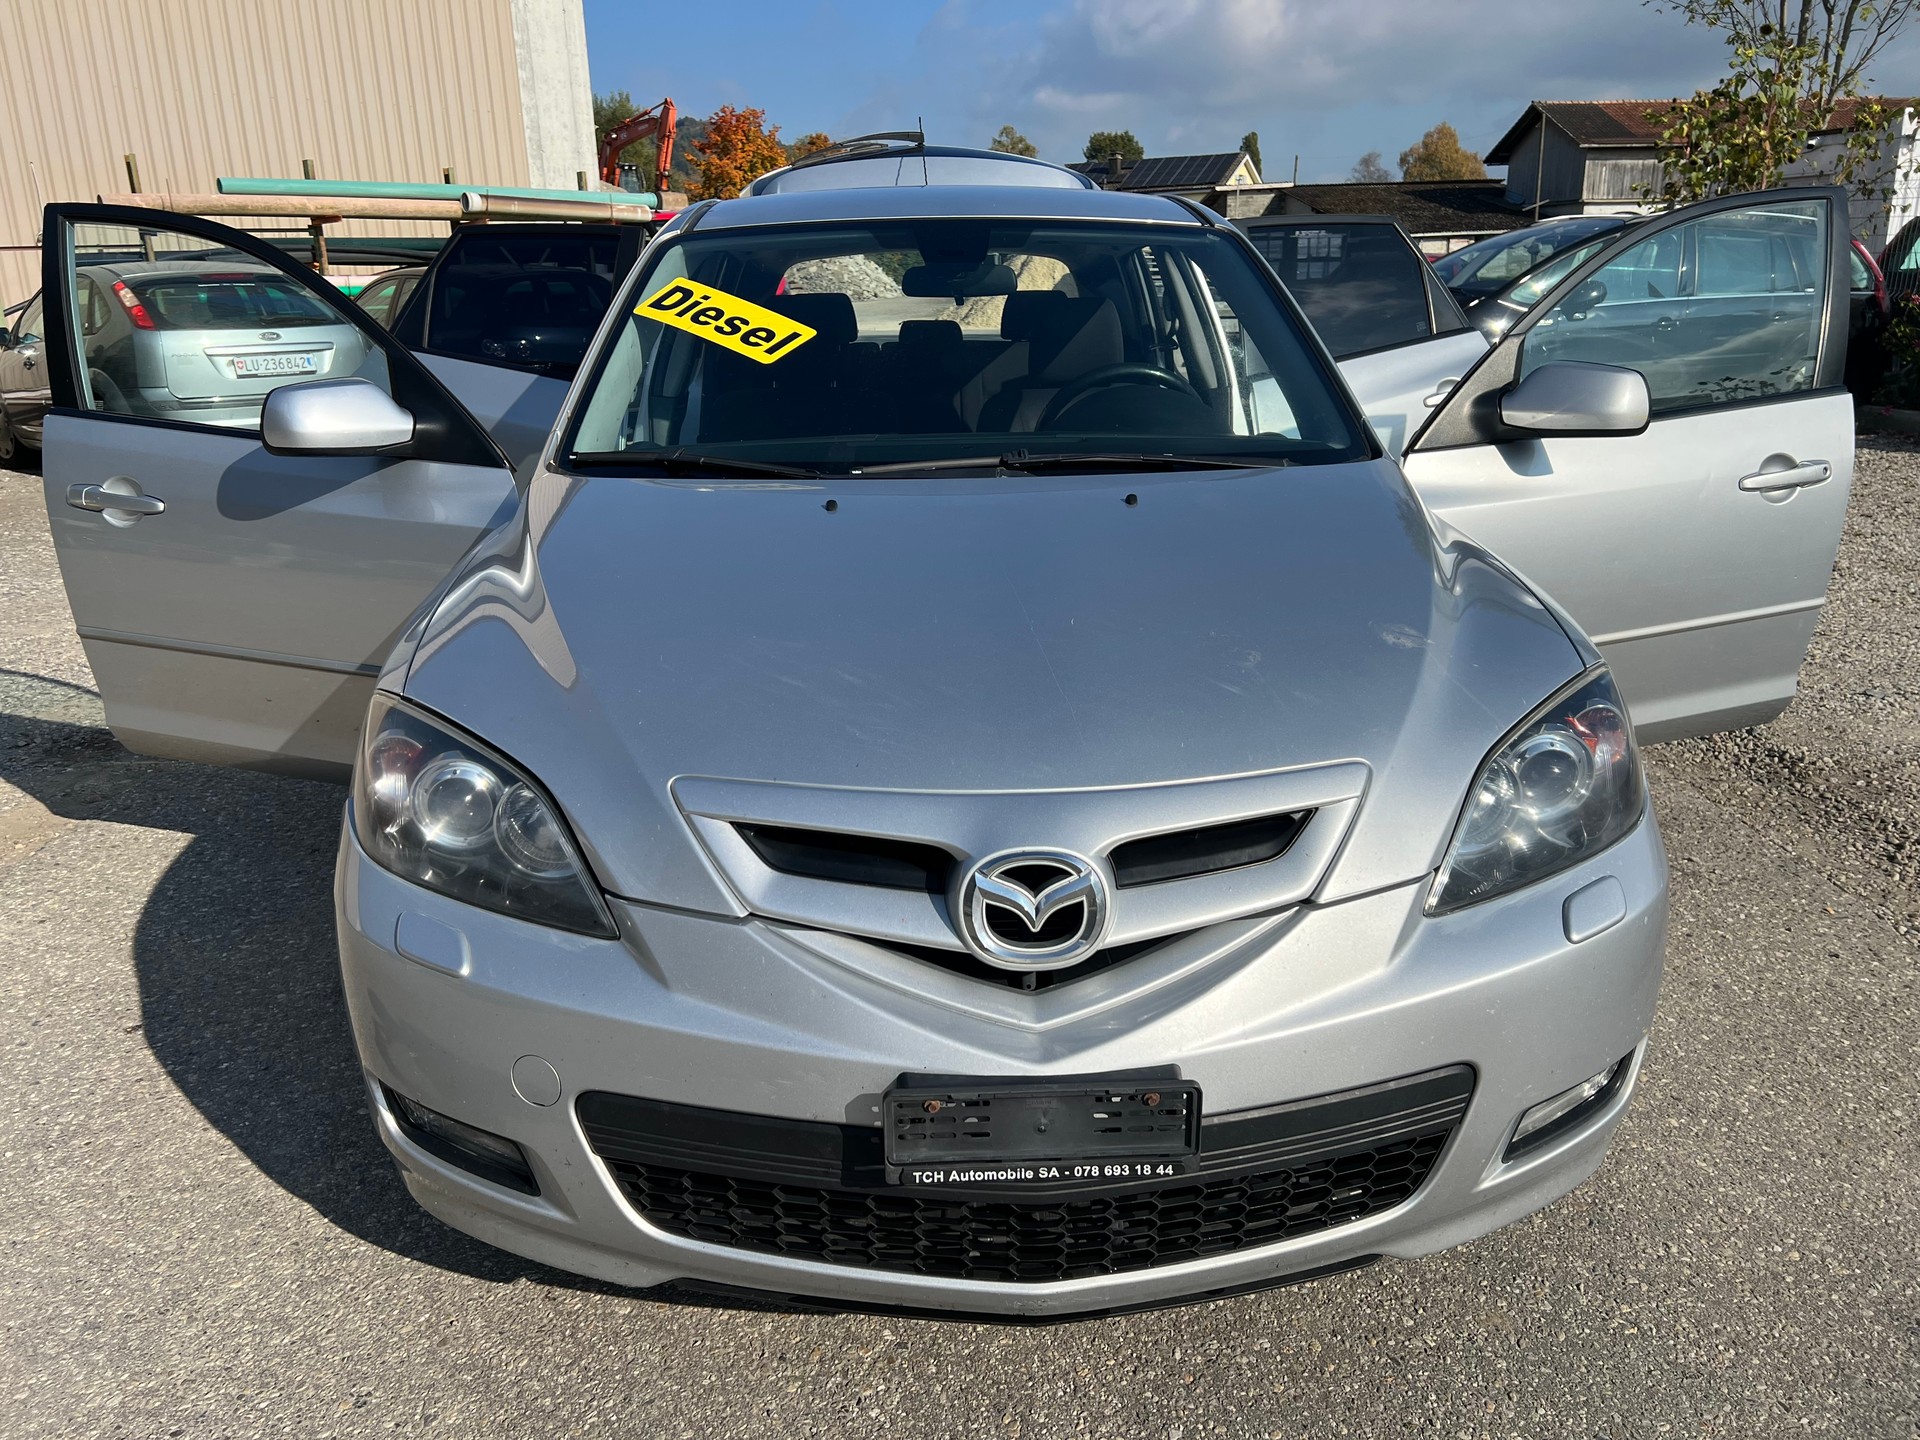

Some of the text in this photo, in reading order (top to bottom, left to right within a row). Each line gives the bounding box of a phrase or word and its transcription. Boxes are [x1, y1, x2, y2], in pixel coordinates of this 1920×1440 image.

[647, 285, 803, 356] Diesel
[912, 1171, 944, 1184] TCH
[948, 1168, 1034, 1182] Automobile
[1038, 1166, 1060, 1178] SA
[1074, 1165, 1100, 1177] 078
[1104, 1164, 1130, 1176] 693
[1134, 1164, 1152, 1176] 18
[1156, 1164, 1174, 1176] 44
